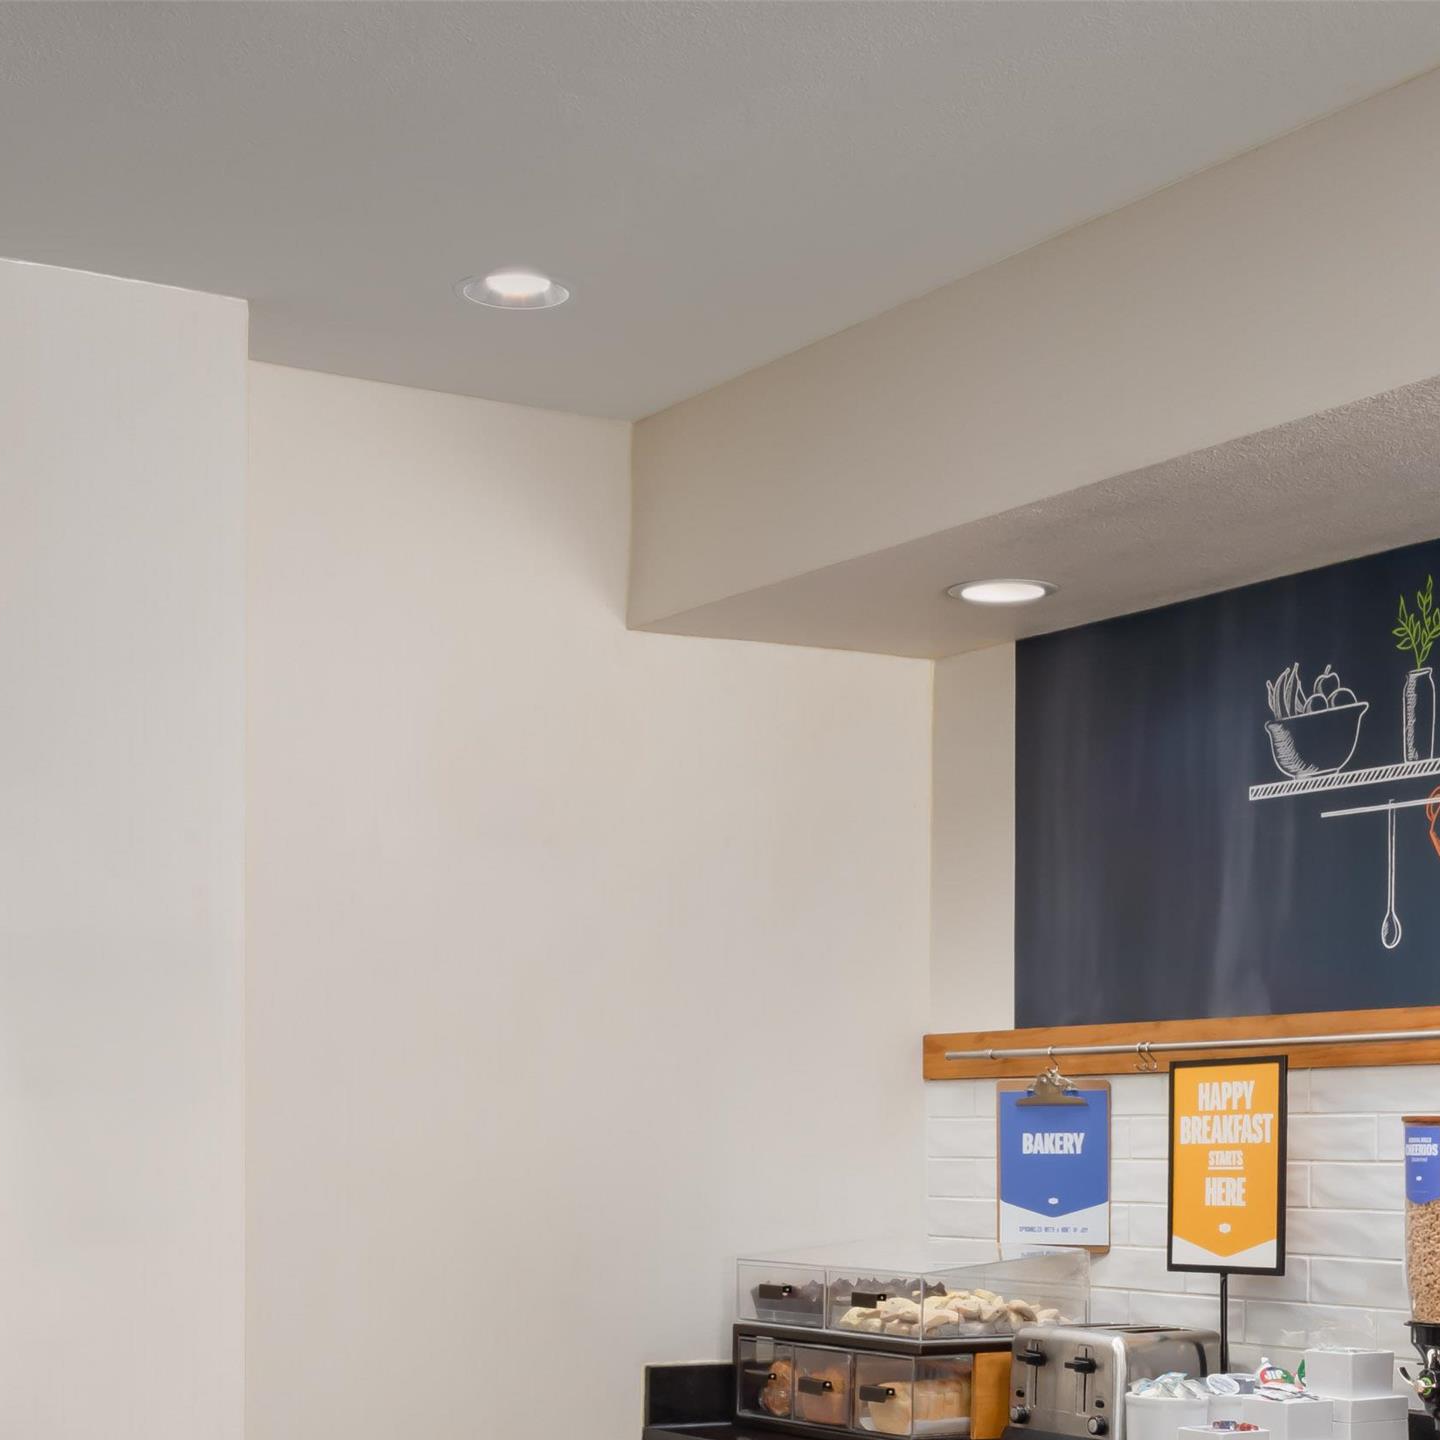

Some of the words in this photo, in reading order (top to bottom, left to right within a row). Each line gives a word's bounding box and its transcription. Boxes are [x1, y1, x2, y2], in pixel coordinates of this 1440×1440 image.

[1197, 1080, 1256, 1111] HAPPY
[1021, 1132, 1085, 1155] BAKERY
[1180, 1113, 1273, 1145] BREAKFAST
[1208, 1150, 1244, 1166] STARTS
[1204, 1176, 1246, 1207] HERE
